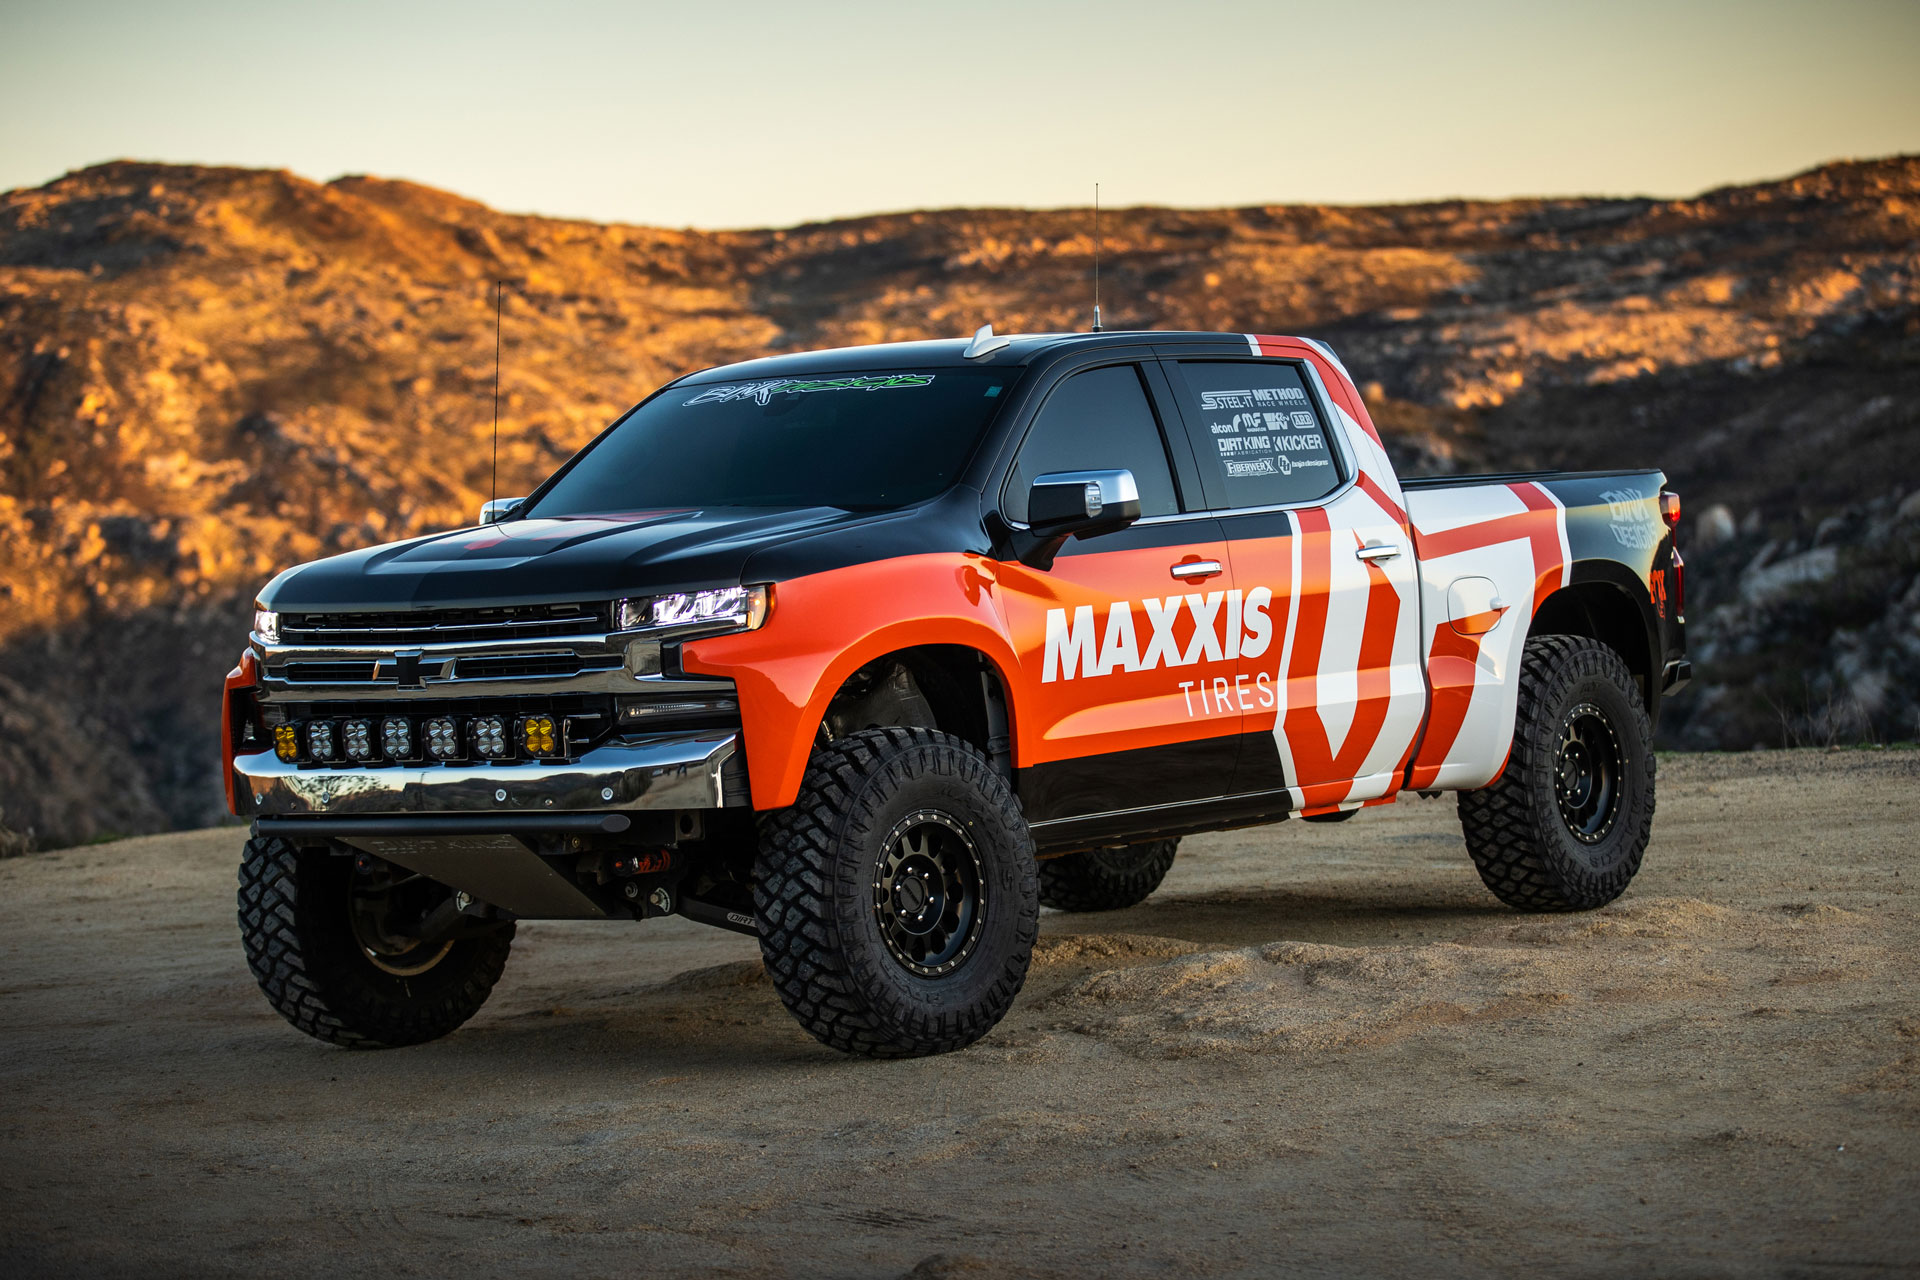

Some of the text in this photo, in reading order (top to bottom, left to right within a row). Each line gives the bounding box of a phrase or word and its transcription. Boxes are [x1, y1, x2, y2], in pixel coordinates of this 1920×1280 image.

[1252, 388, 1304, 401] METHOD
[1217, 396, 1254, 409] STEEL-IT
[1293, 413, 1313, 426] ARB
[1211, 422, 1234, 434] alcon
[1217, 435, 1271, 452] DIRT KING
[1280, 434, 1323, 451] KICKER
[1609, 522, 1658, 549] DESIGNS
[1041, 586, 1273, 684] MAXXIS
[1178, 671, 1275, 717] TIRES
[730, 914, 753, 925] DIRT
